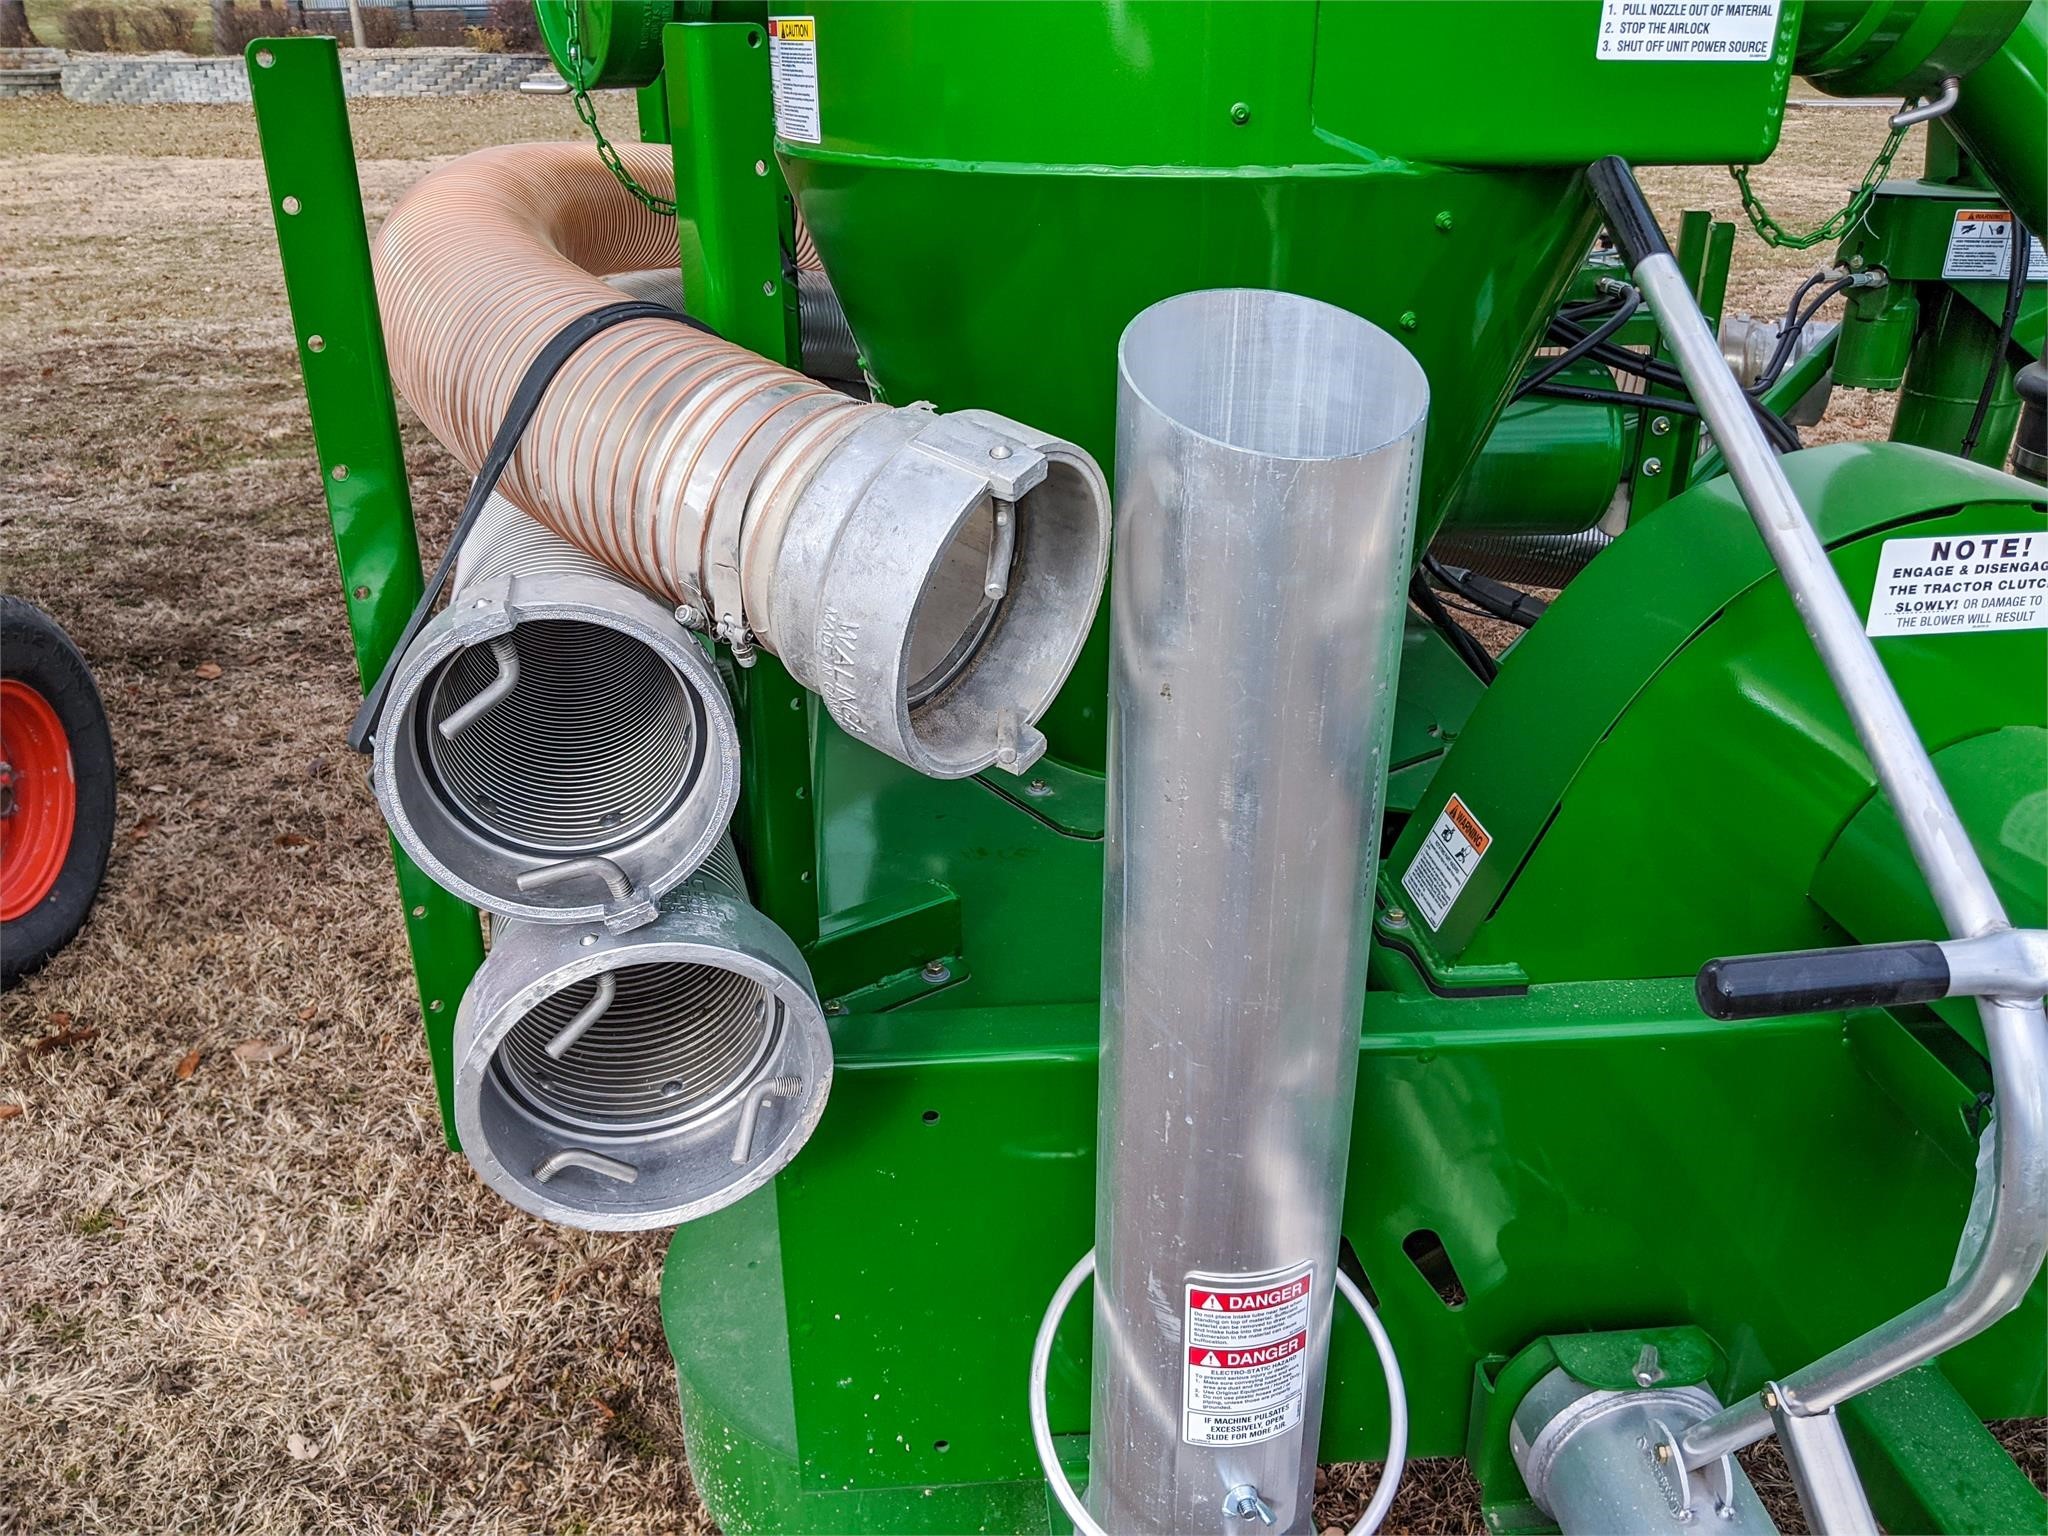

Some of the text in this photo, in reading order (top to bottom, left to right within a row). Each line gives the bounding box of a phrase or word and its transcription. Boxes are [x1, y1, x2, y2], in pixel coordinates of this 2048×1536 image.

[1608, 4, 1773, 17] 1. PULL NOZZLE OUT OF MATERIAL
[785, 23, 809, 38] CAUTION
[1605, 22, 1710, 34] 2. STOP THE AIRLOCK
[1602, 40, 1768, 53] 3. SHUT OFF UNIT POWER SOURCE
[1931, 537, 2032, 561] NOTE!
[1892, 566, 1954, 578] ENGAGE
[1959, 565, 1969, 575] &
[1889, 585, 1917, 596] THE
[1923, 581, 1992, 594] TRACTOR
[1895, 595, 2043, 613] SLOWLY! OR DAMAGE TO
[1897, 611, 2035, 628] THE BLOWER WILL RESULT
[1456, 812, 1483, 847] WARNING
[1229, 1282, 1302, 1310] DANGER
[1194, 1317, 1219, 1325] standing
[1240, 1321, 1265, 1329] removed
[1194, 1332, 1229, 1340] Submersion
[1248, 1330, 1271, 1338] material
[1227, 1338, 1298, 1366] DANGER
[1211, 1355, 1297, 1376] ELECTRO-STATIC HAZARD
[1240, 1386, 1269, 1395] Equipment
[1214, 1415, 1253, 1424] MACHINE
[1254, 1403, 1290, 1421] PULSATES
[1210, 1414, 1285, 1433] EXCESSIVELY, OPEN
[1206, 1433, 1229, 1441] SLIDE
[1249, 1428, 1271, 1438] MORE
